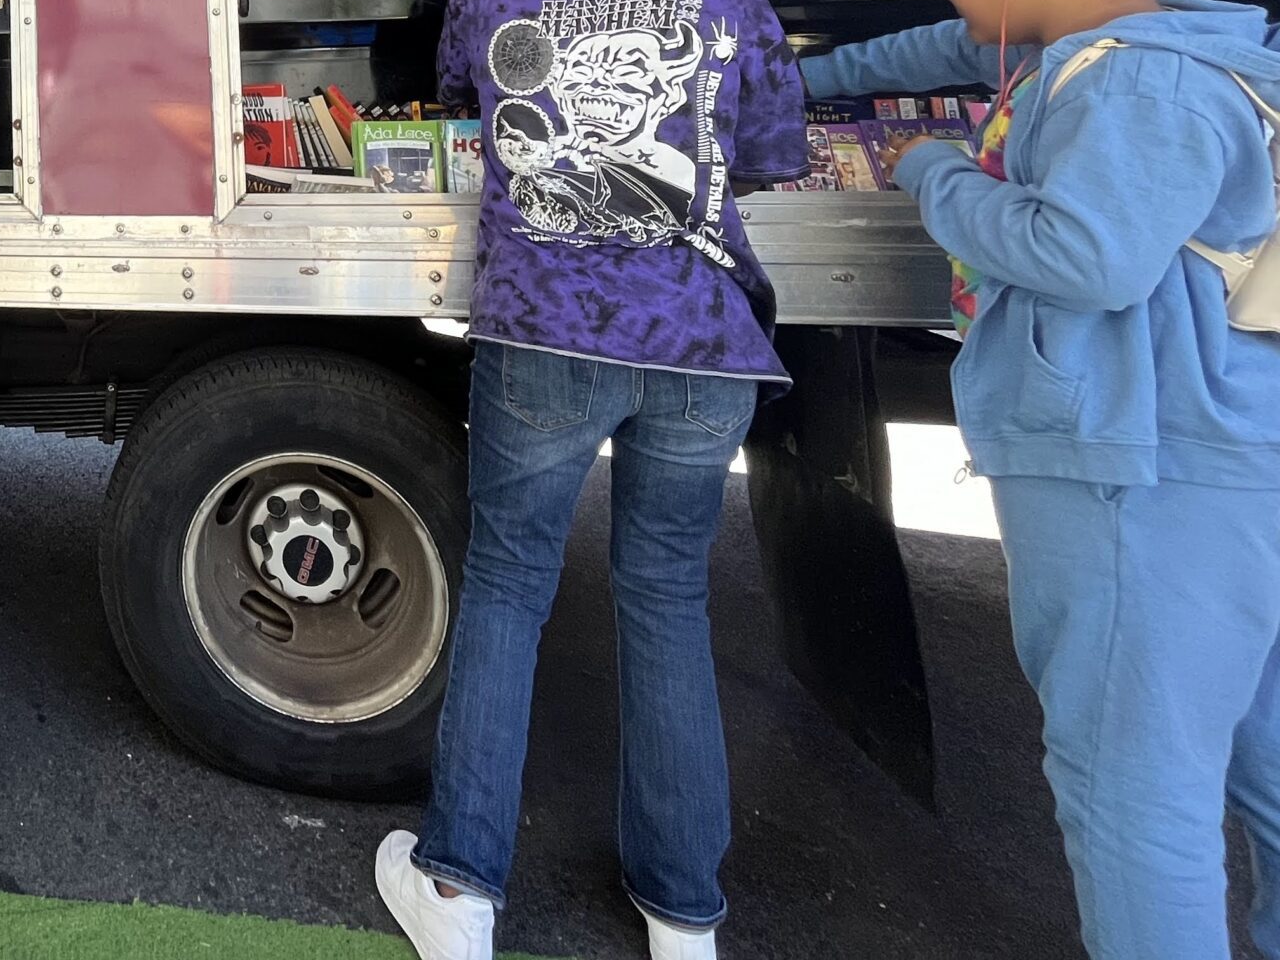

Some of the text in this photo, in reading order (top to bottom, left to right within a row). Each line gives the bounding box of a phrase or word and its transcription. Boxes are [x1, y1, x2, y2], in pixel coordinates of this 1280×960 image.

[536, 7, 677, 39] MAYHEM
[705, 70, 723, 115] DEVIL
[363, 123, 392, 141] Ada
[805, 113, 852, 123] NIGHT
[710, 136, 725, 164] THE
[830, 132, 858, 143] ace
[705, 165, 726, 223] DETAILS
[297, 537, 320, 584] GMC
